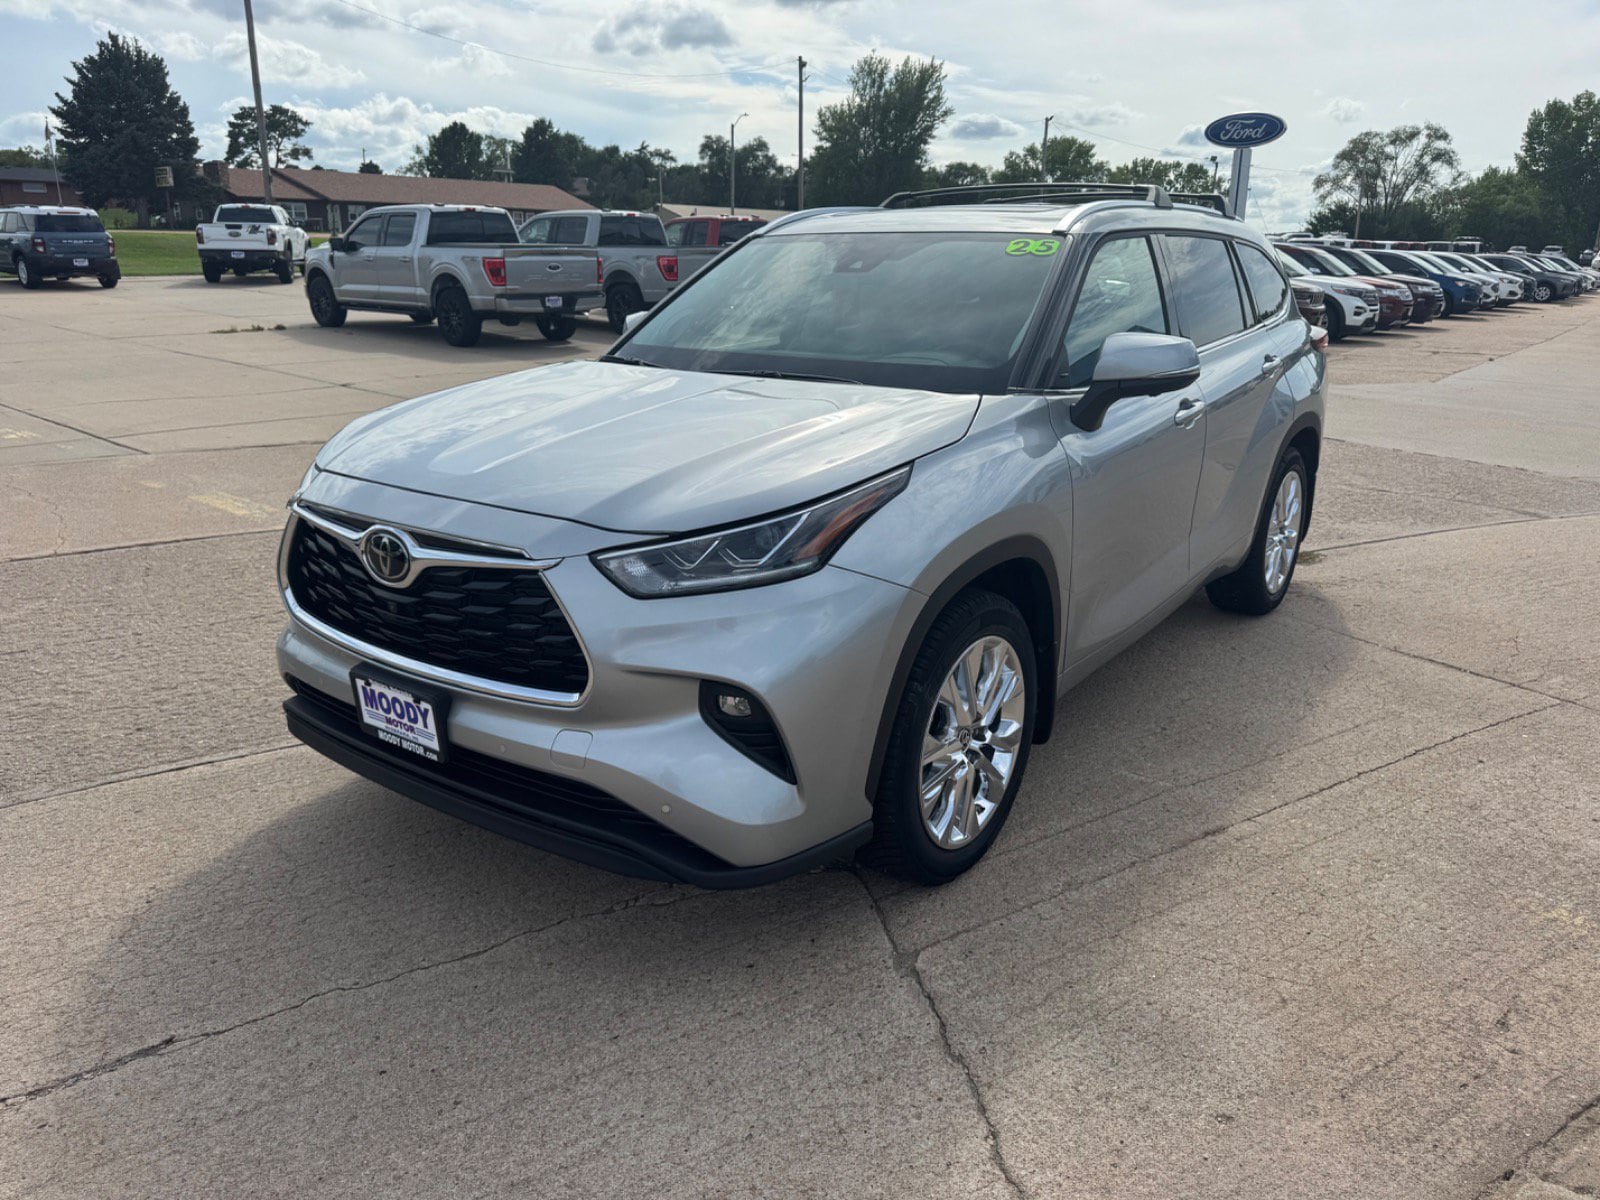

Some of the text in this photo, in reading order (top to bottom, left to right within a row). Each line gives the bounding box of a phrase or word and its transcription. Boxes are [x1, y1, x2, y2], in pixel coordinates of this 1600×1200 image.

[1220, 119, 1267, 140] Ford
[1008, 239, 1057, 254] 25
[361, 685, 430, 729] MOODY
[385, 716, 416, 735] MOTOR
